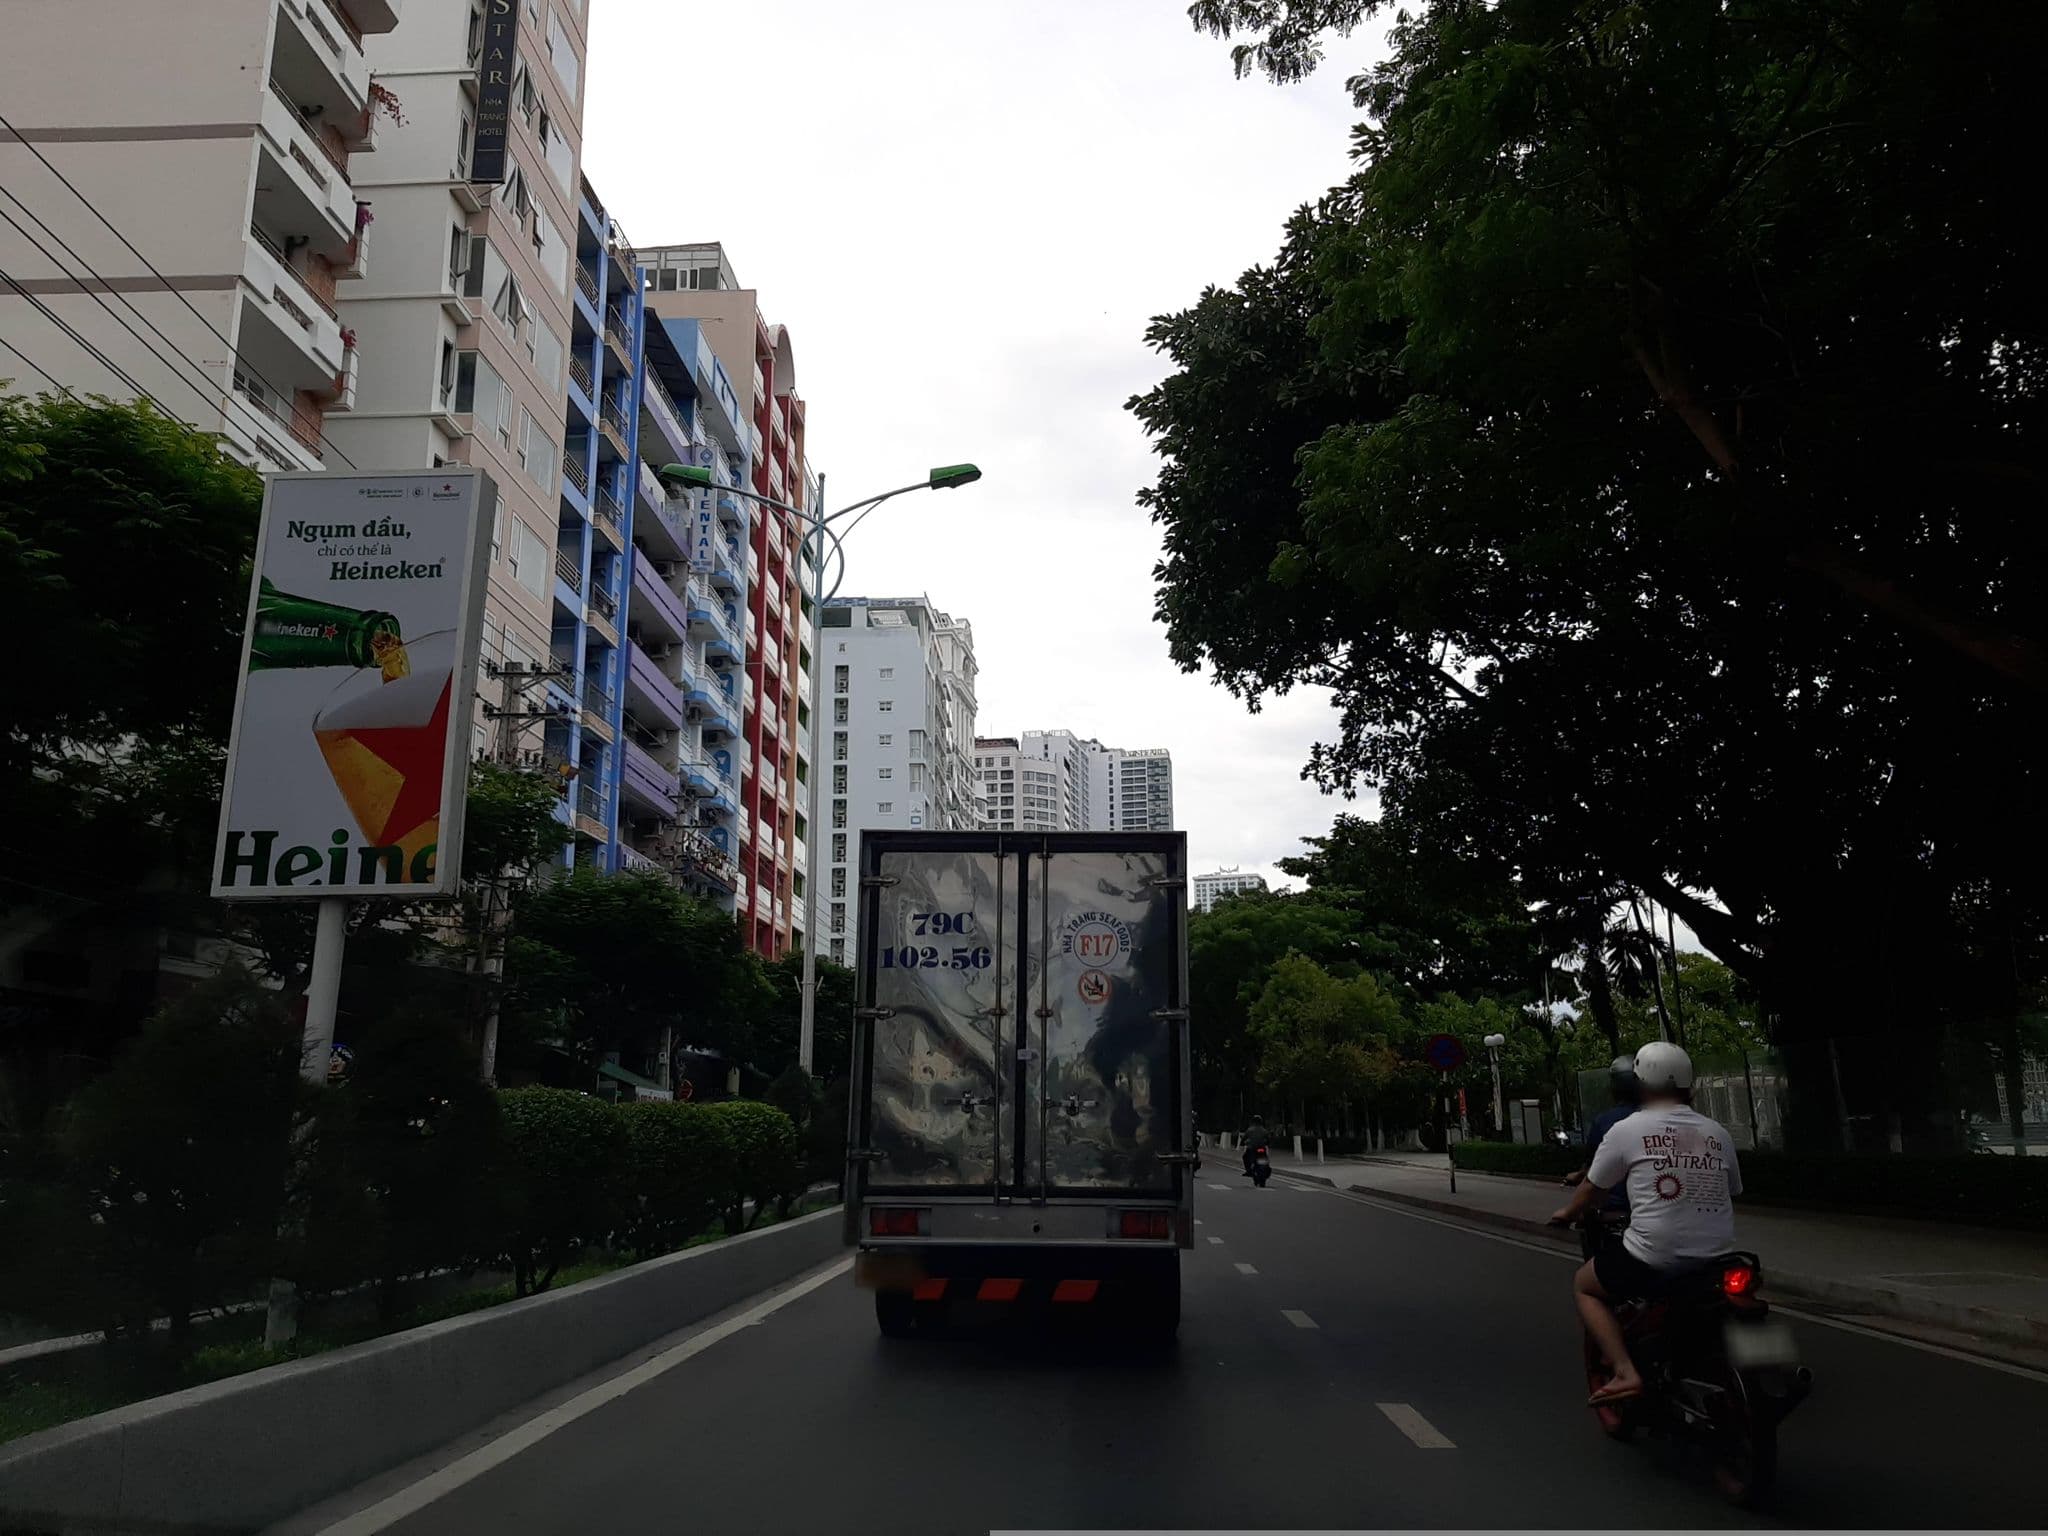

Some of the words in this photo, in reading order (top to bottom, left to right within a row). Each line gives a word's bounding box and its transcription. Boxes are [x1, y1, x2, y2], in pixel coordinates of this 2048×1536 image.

[489, 0, 510, 85] STAR
[478, 128, 504, 136] HOTEL
[698, 464, 711, 560] IENTAL
[287, 521, 355, 543] Ngụm
[362, 516, 412, 539] đầu,
[329, 560, 443, 581] Heineken
[912, 911, 975, 936] 79C
[1066, 911, 1096, 932] TRANG
[1098, 911, 1130, 953] SEAFOODS
[879, 945, 992, 970] 102.56
[1080, 934, 1114, 957] F17
